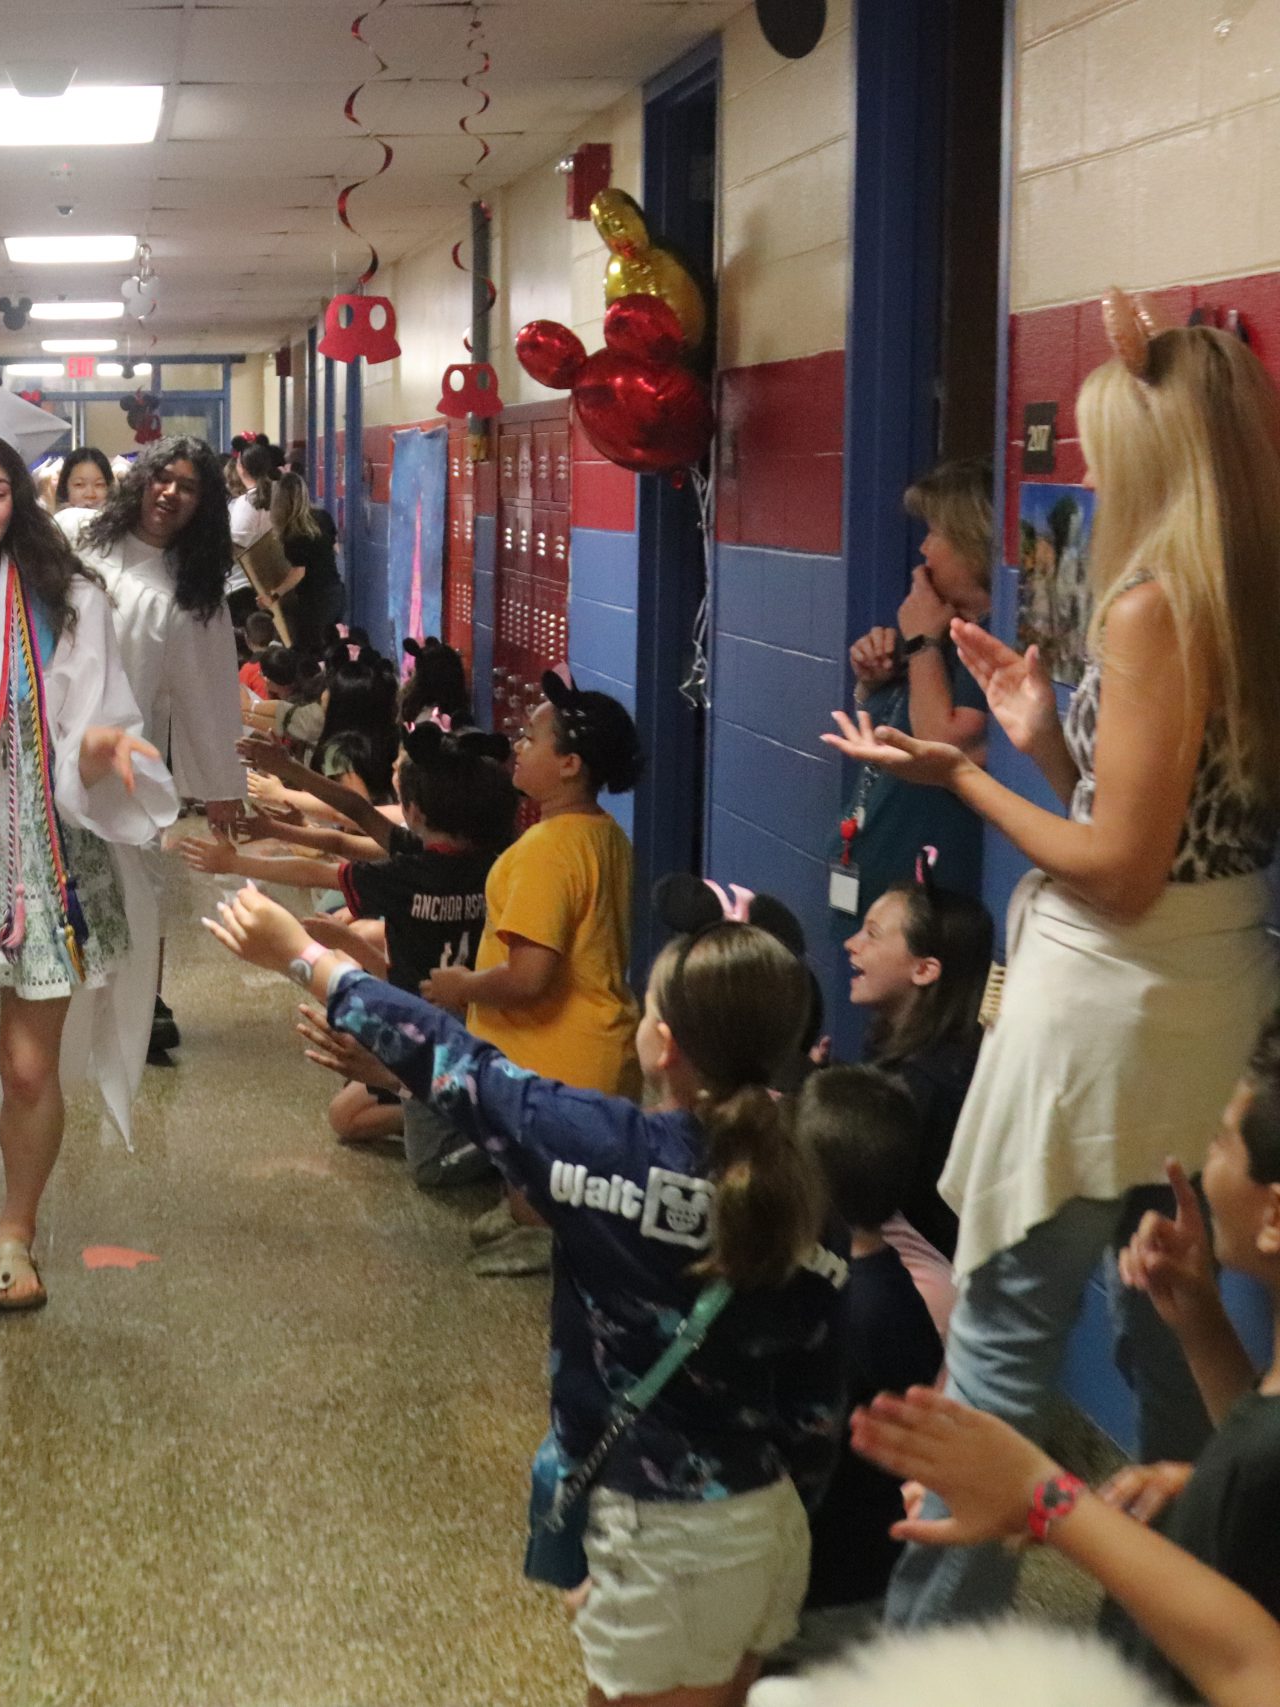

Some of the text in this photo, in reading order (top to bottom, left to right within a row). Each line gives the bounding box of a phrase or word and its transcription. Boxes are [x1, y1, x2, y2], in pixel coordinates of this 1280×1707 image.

[67, 357, 96, 379] EXIT
[411, 893, 463, 922] ANCHOR
[550, 1160, 645, 1220] Walt
